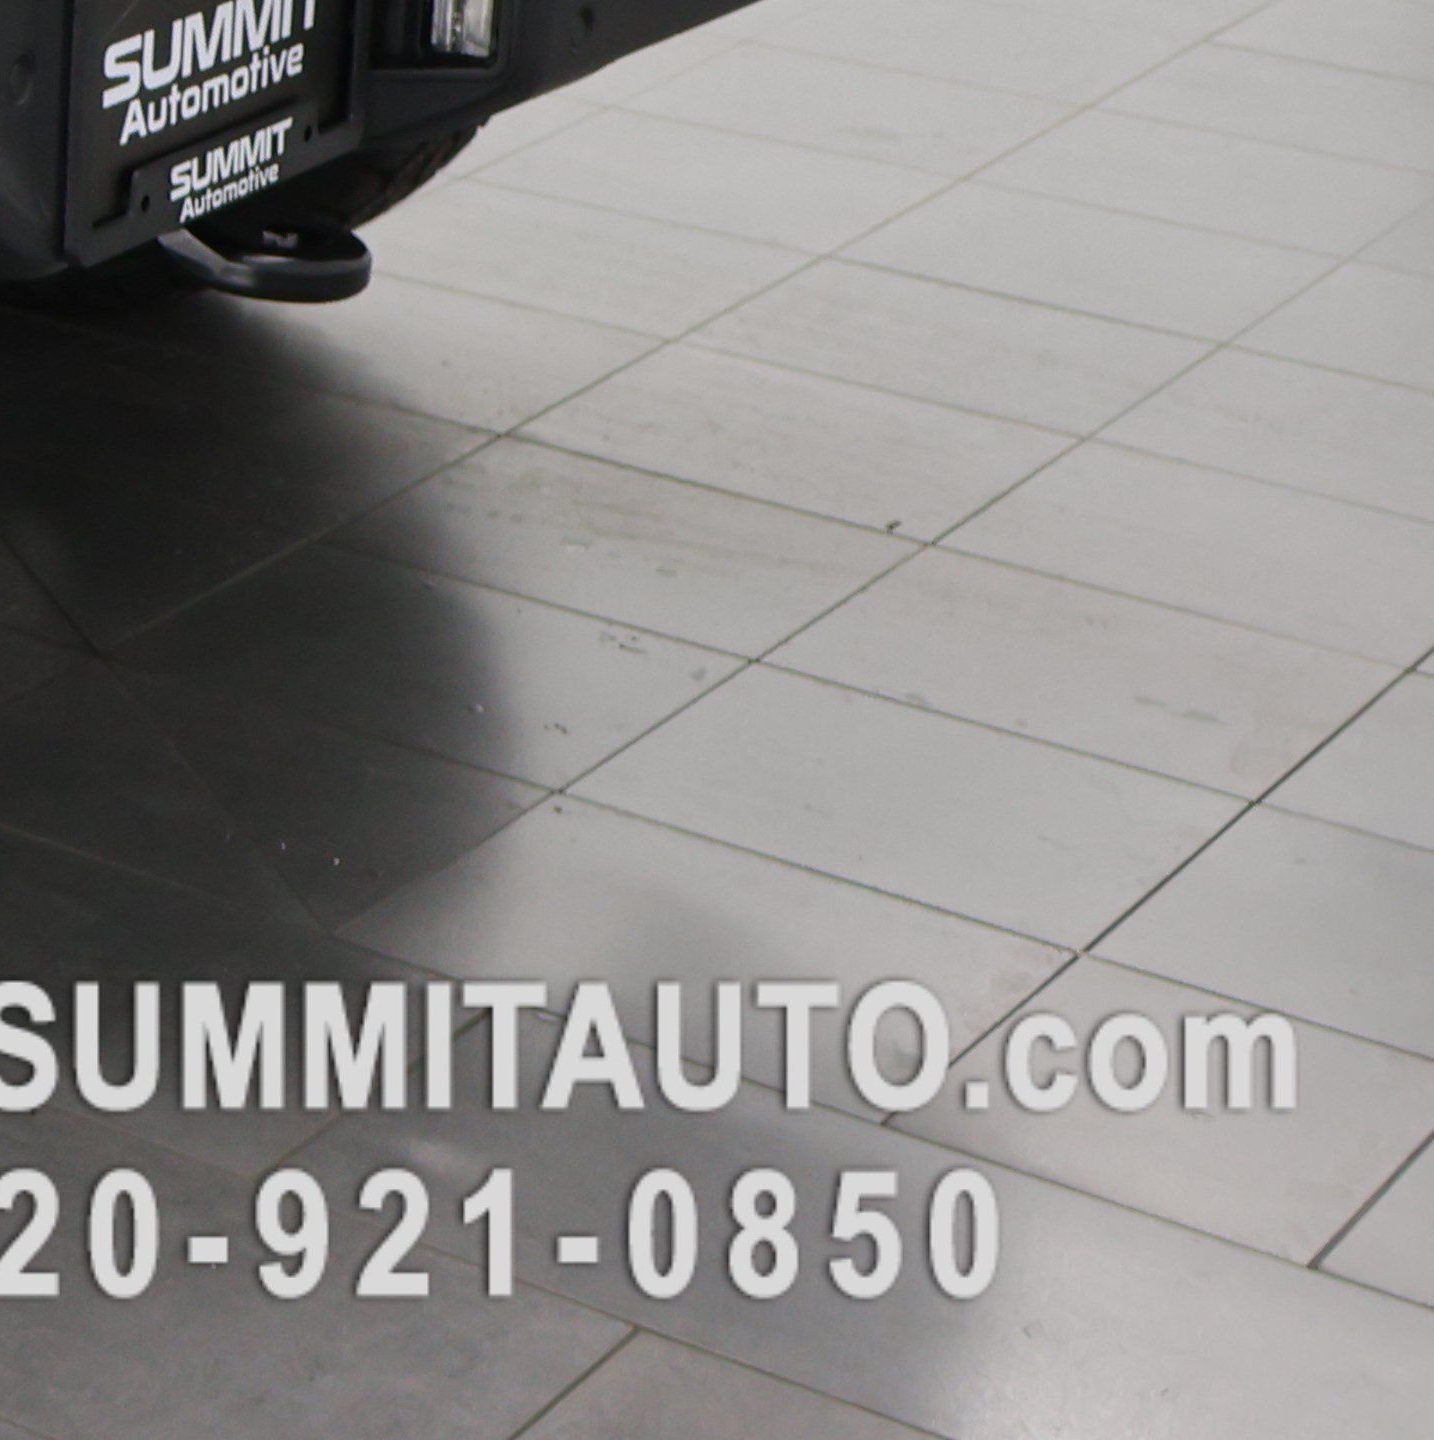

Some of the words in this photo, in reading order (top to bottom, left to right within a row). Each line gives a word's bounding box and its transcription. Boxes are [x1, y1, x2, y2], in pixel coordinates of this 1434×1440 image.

[119, 40, 305, 145] Automotive
[169, 116, 294, 202] SUMMIT
[179, 163, 279, 224] Automotive
